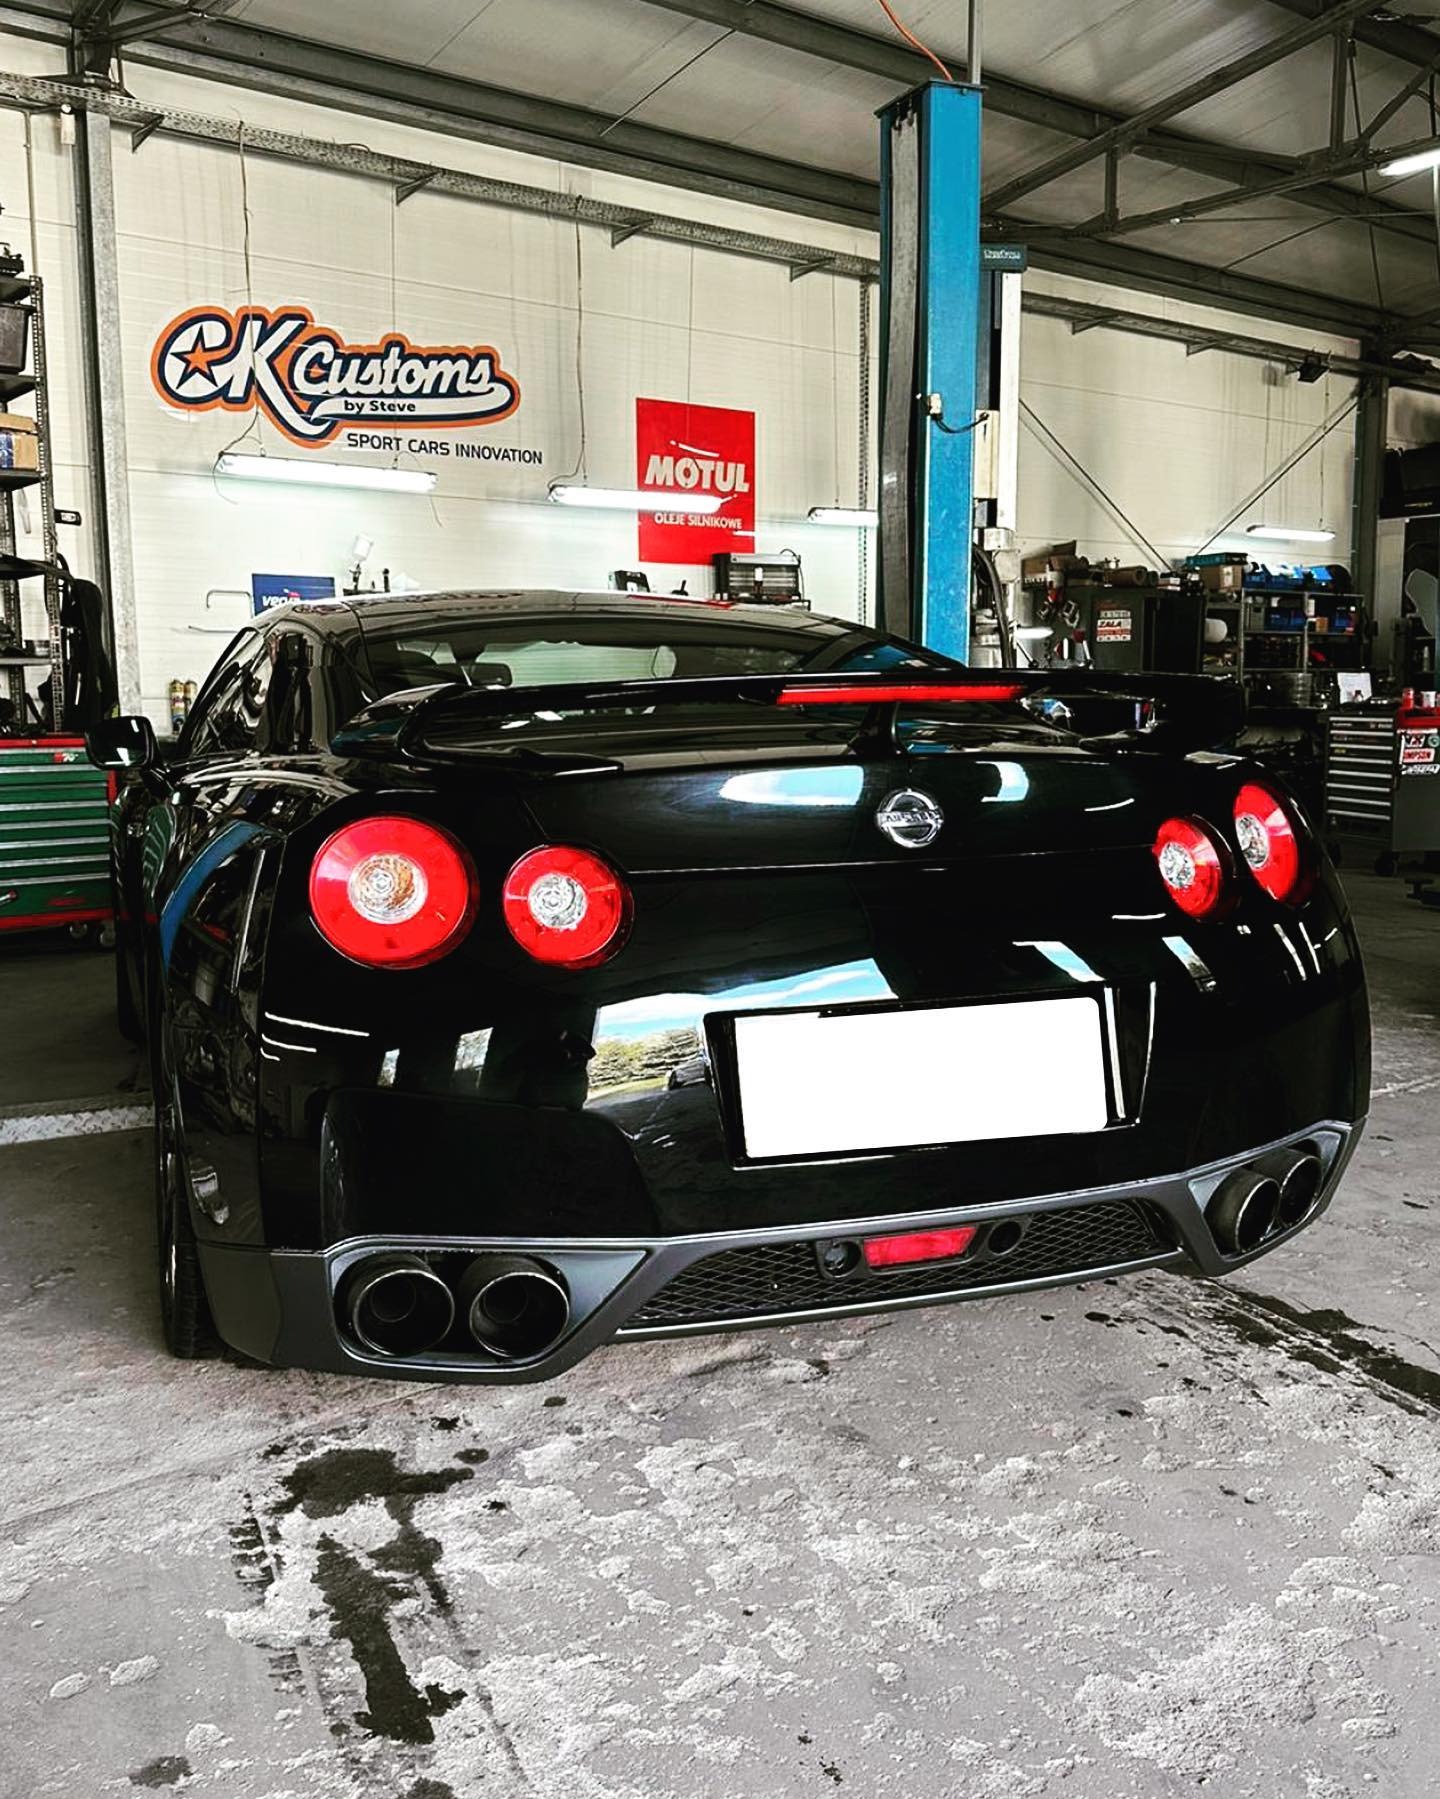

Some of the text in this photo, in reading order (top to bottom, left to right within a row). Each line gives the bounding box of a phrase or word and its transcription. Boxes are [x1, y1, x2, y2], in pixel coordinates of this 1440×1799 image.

[302, 340, 497, 398] Customs
[344, 399, 416, 414] by Steve
[346, 432, 543, 465] SPORT CARS INNOVATION
[644, 455, 750, 493] MOTUL
[654, 512, 742, 530] OLEJE SILNIKOWE
